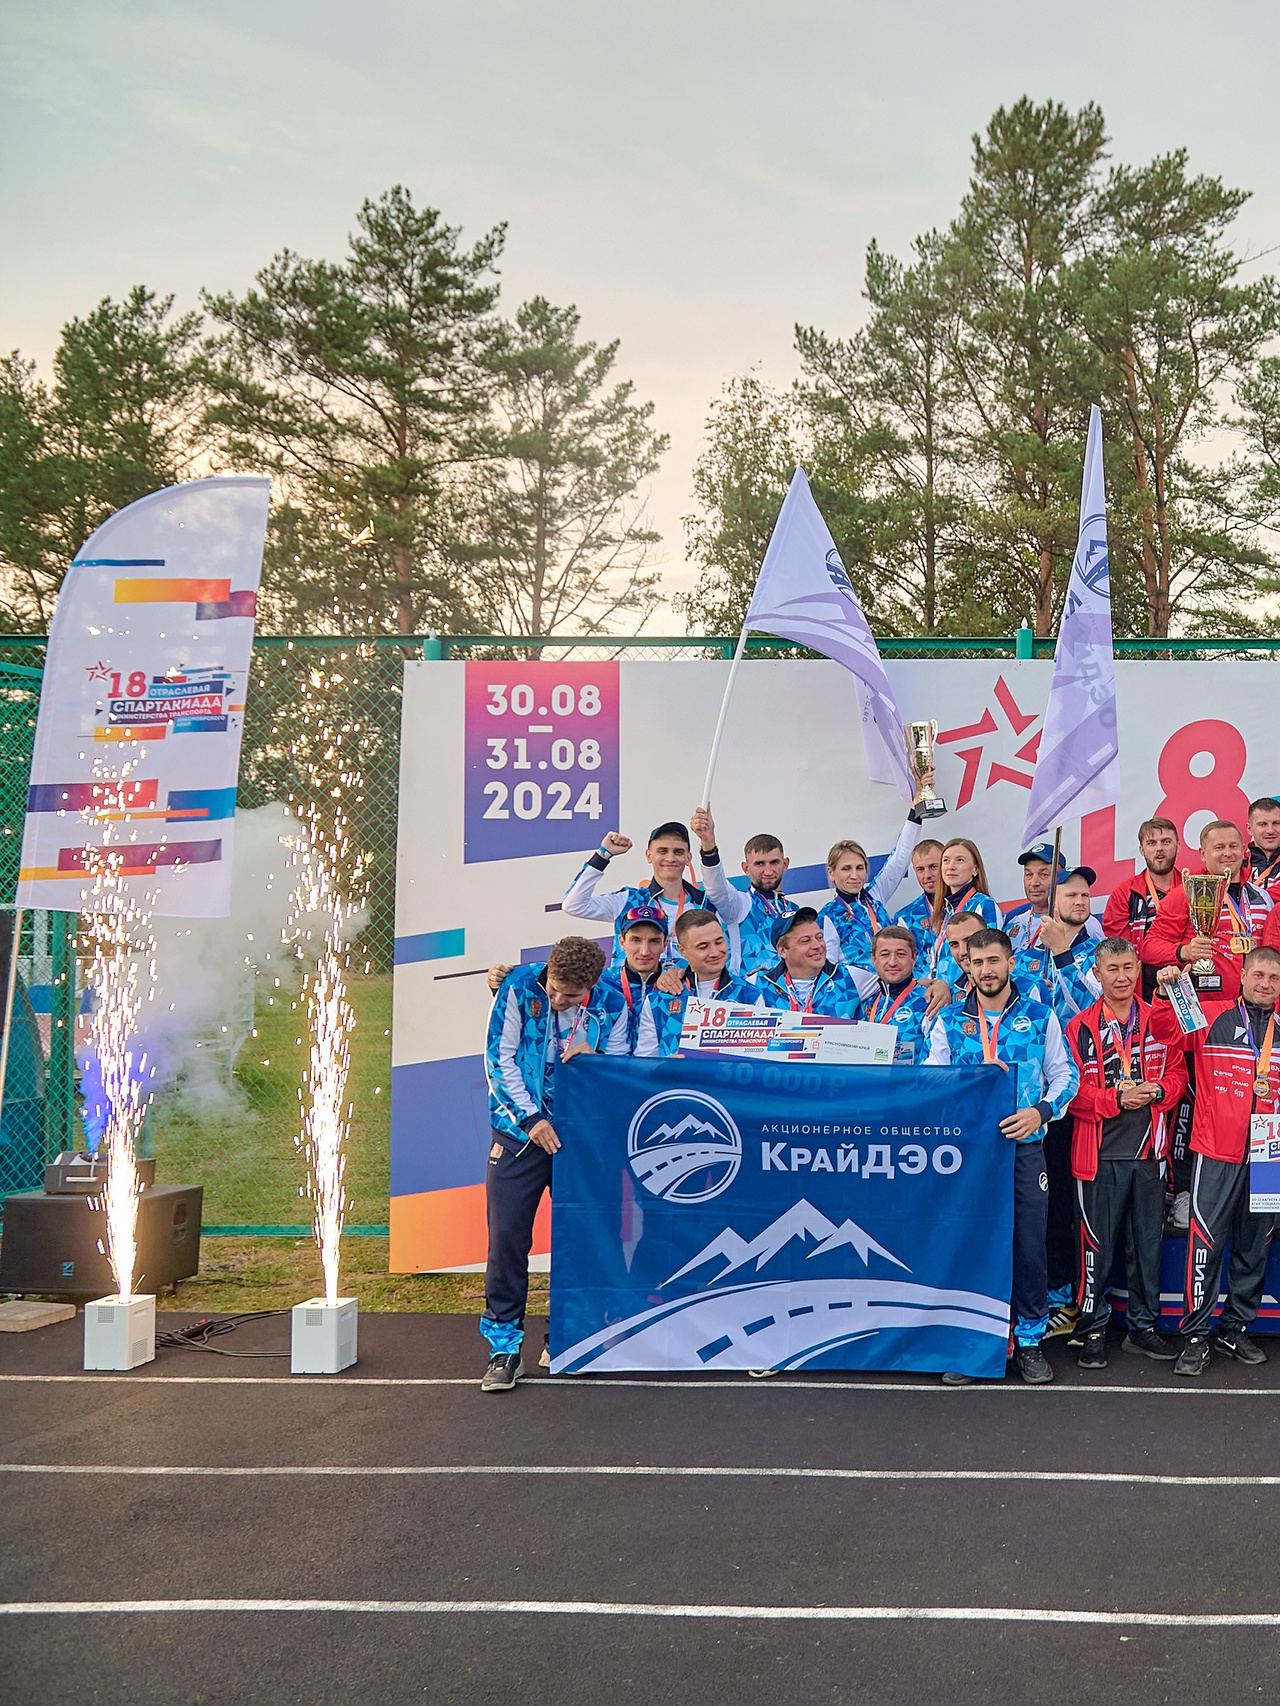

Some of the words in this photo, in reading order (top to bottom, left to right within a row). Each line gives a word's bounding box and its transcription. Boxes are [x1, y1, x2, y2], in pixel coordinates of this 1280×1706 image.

[107, 671, 147, 699] 18
[149, 684, 212, 697] ОТРАСЛЕВАЯ
[113, 696, 222, 713] СПАРТАКИАДА
[486, 684, 602, 716] 30.08
[112, 711, 168, 720] ИНИСТЕРСТВА
[486, 738, 602, 770] 31.08
[482, 781, 603, 820] 2024
[700, 1007, 727, 1027] 18
[727, 1019, 769, 1027] ОТРАСЛЕВАЯ
[702, 1029, 775, 1039] СПАРТАКИАДА
[762, 1124, 872, 1135] АКЦИОНЕРНОЕ
[880, 1125, 962, 1137] ОБЩЕСТВО
[1174, 1103, 1190, 1160] БРИЗ
[1082, 1250, 1094, 1313] БРИЗ
[1193, 1248, 1208, 1312] БРИЗ
